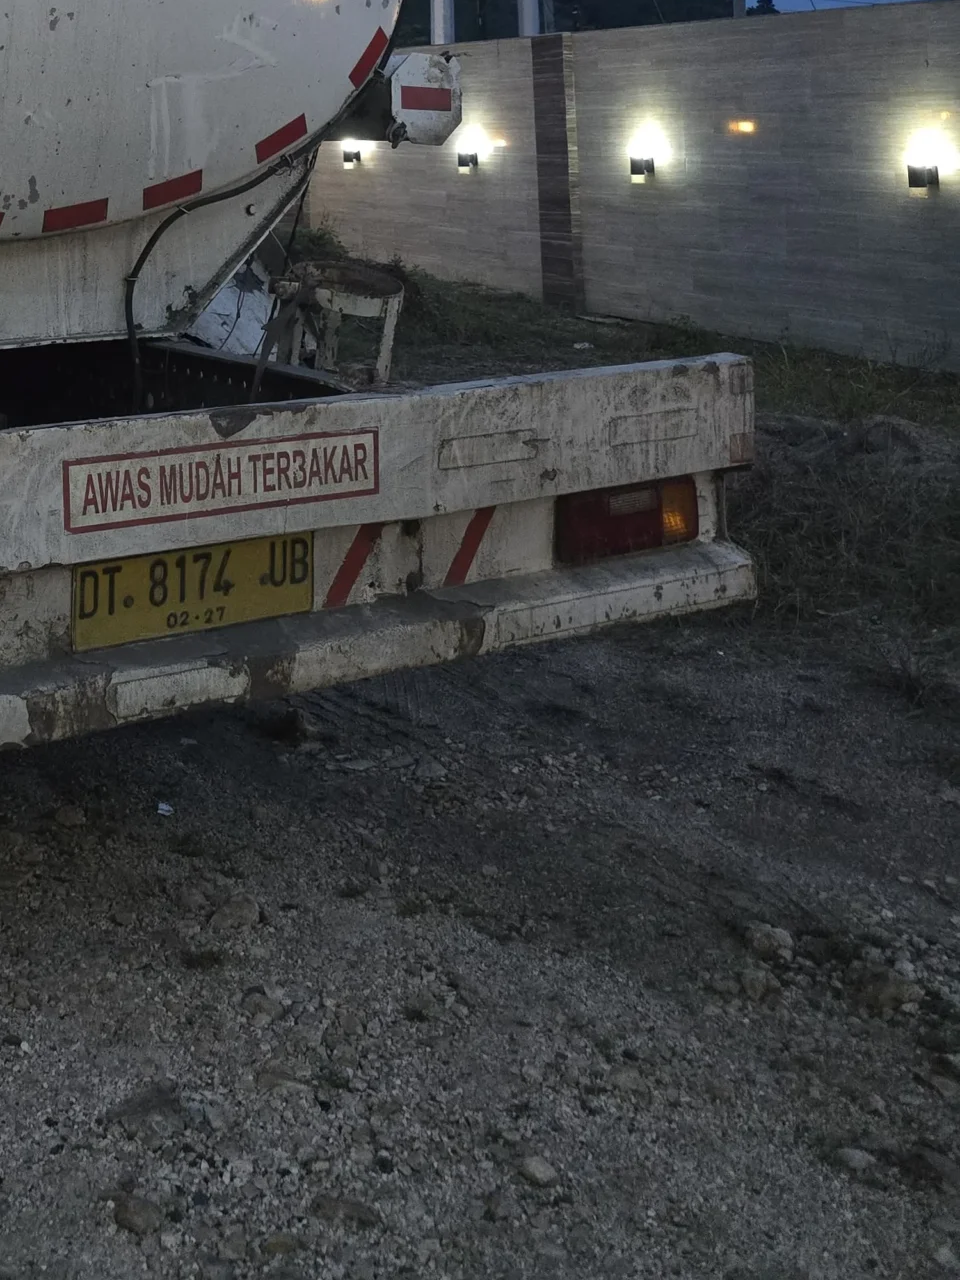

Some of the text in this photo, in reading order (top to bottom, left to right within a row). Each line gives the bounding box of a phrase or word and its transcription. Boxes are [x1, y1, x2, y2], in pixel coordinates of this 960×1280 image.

[82, 442, 368, 515] AWAS MUDAH TERBAKAR
[149, 547, 235, 608] 8174
